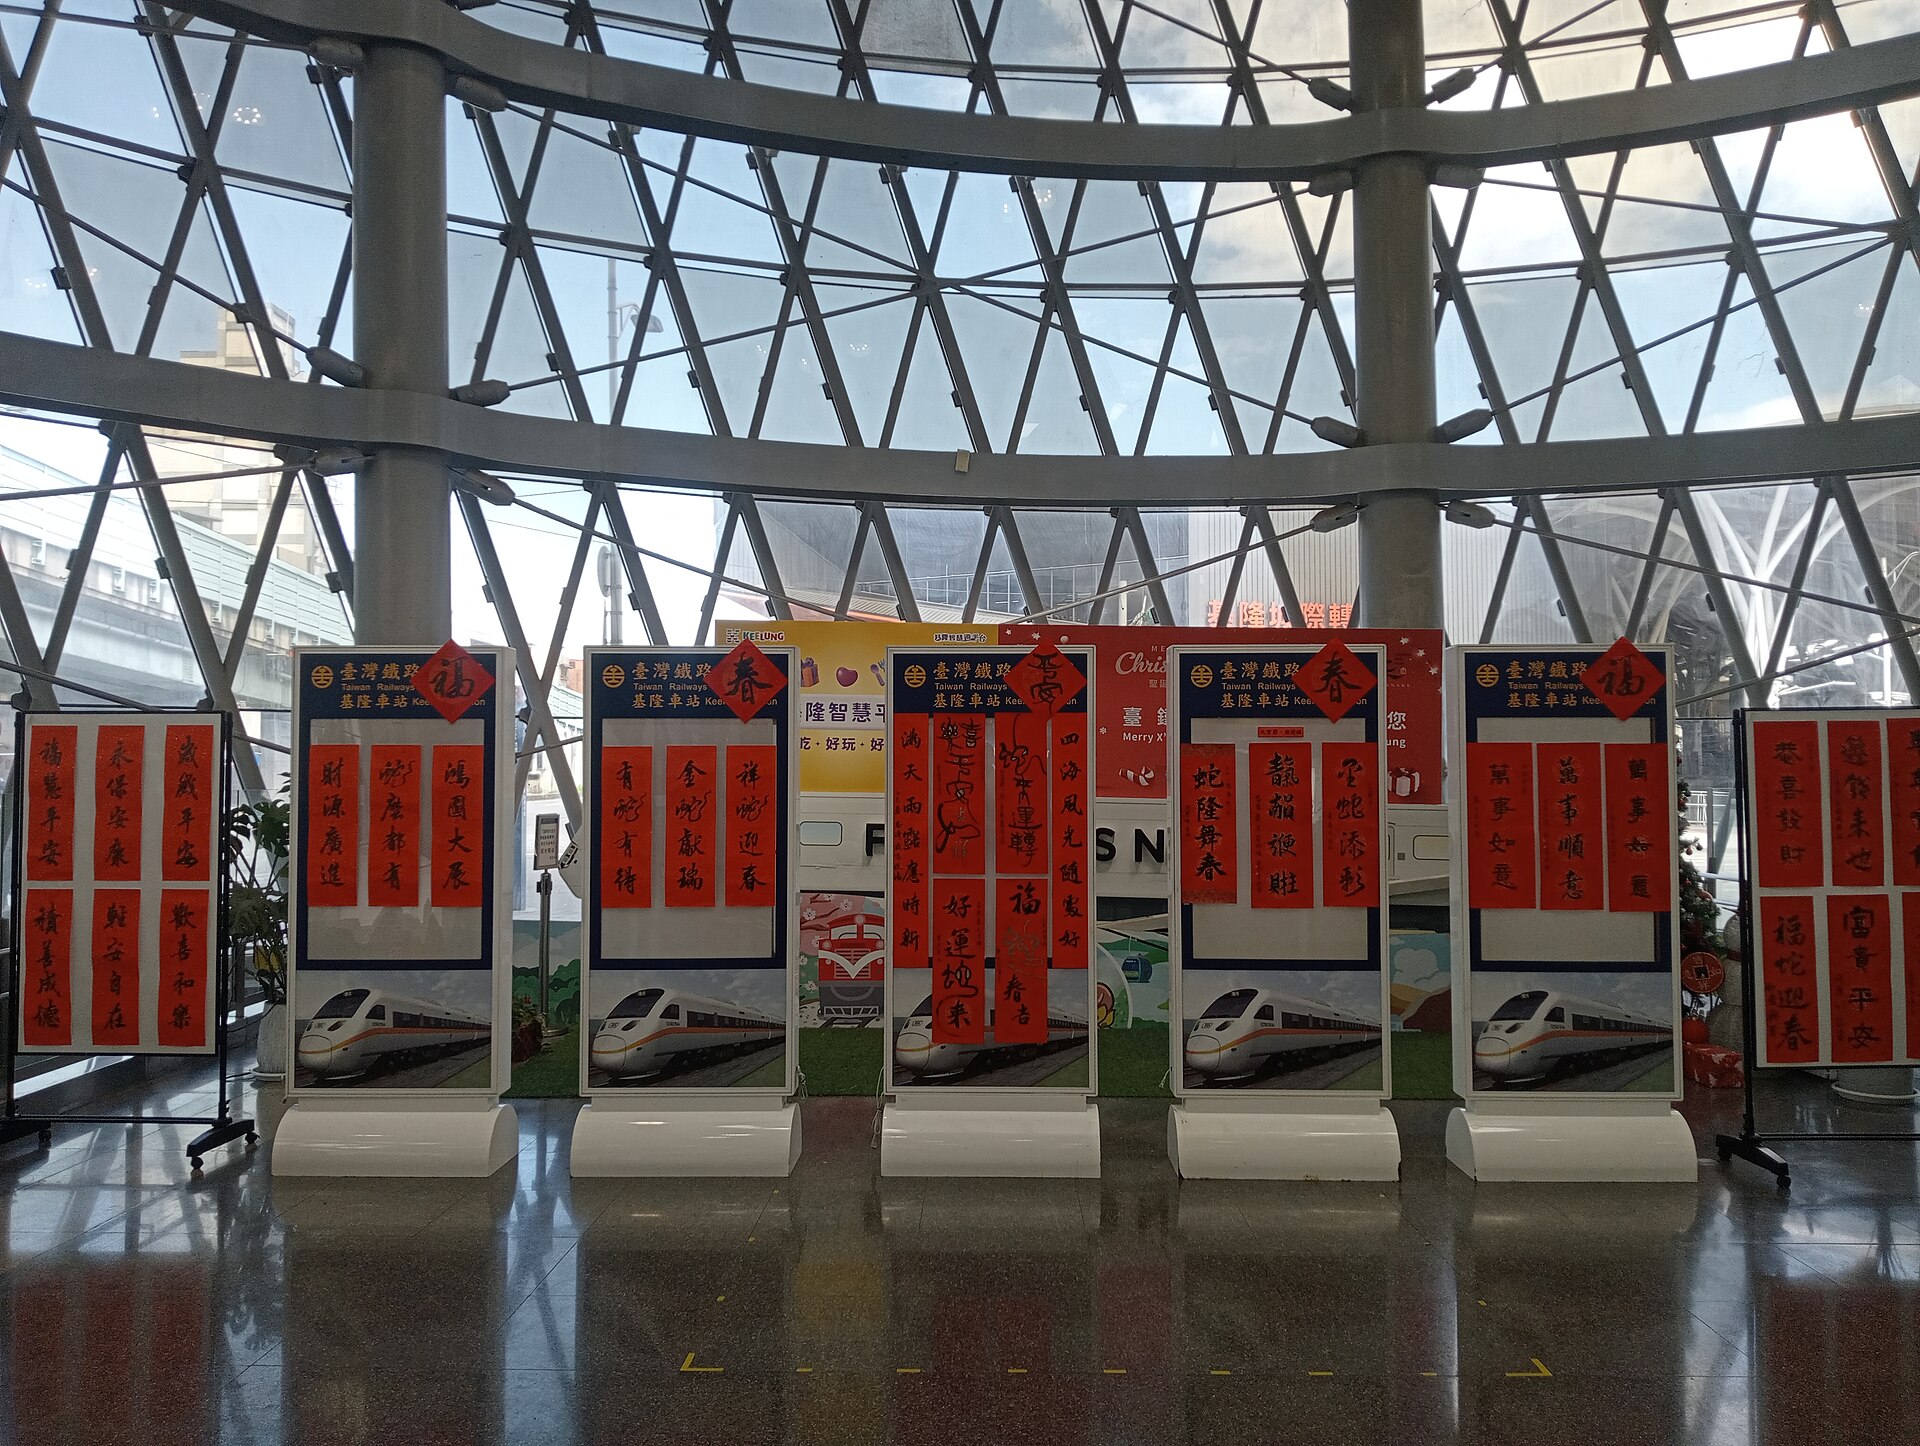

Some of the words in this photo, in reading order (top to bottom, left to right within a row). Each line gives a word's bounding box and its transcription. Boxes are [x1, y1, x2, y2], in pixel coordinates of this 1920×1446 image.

[743, 632, 784, 641] KEELUNG
[429, 656, 475, 698] 福
[723, 651, 774, 704] 春
[1313, 651, 1362, 703] 春
[1597, 653, 1646, 697] 福
[633, 683, 663, 691] Taiwan
[669, 683, 708, 692] Railways
[935, 682, 964, 690] Taiwan
[970, 682, 1008, 692] Railways
[1221, 682, 1251, 690] Taiwan
[1257, 682, 1296, 691] Railways
[1508, 682, 1538, 690] Taiwan
[1545, 682, 1584, 690] Railways
[339, 694, 408, 709] 基隆車站
[631, 693, 700, 709] 基隆車站
[933, 693, 1000, 709] 基隆車站
[1220, 693, 1290, 708] 基隆車站
[1507, 692, 1577, 708] 基隆車站
[1123, 732, 1154, 744] Merry
[320, 757, 346, 887] 財源廣進
